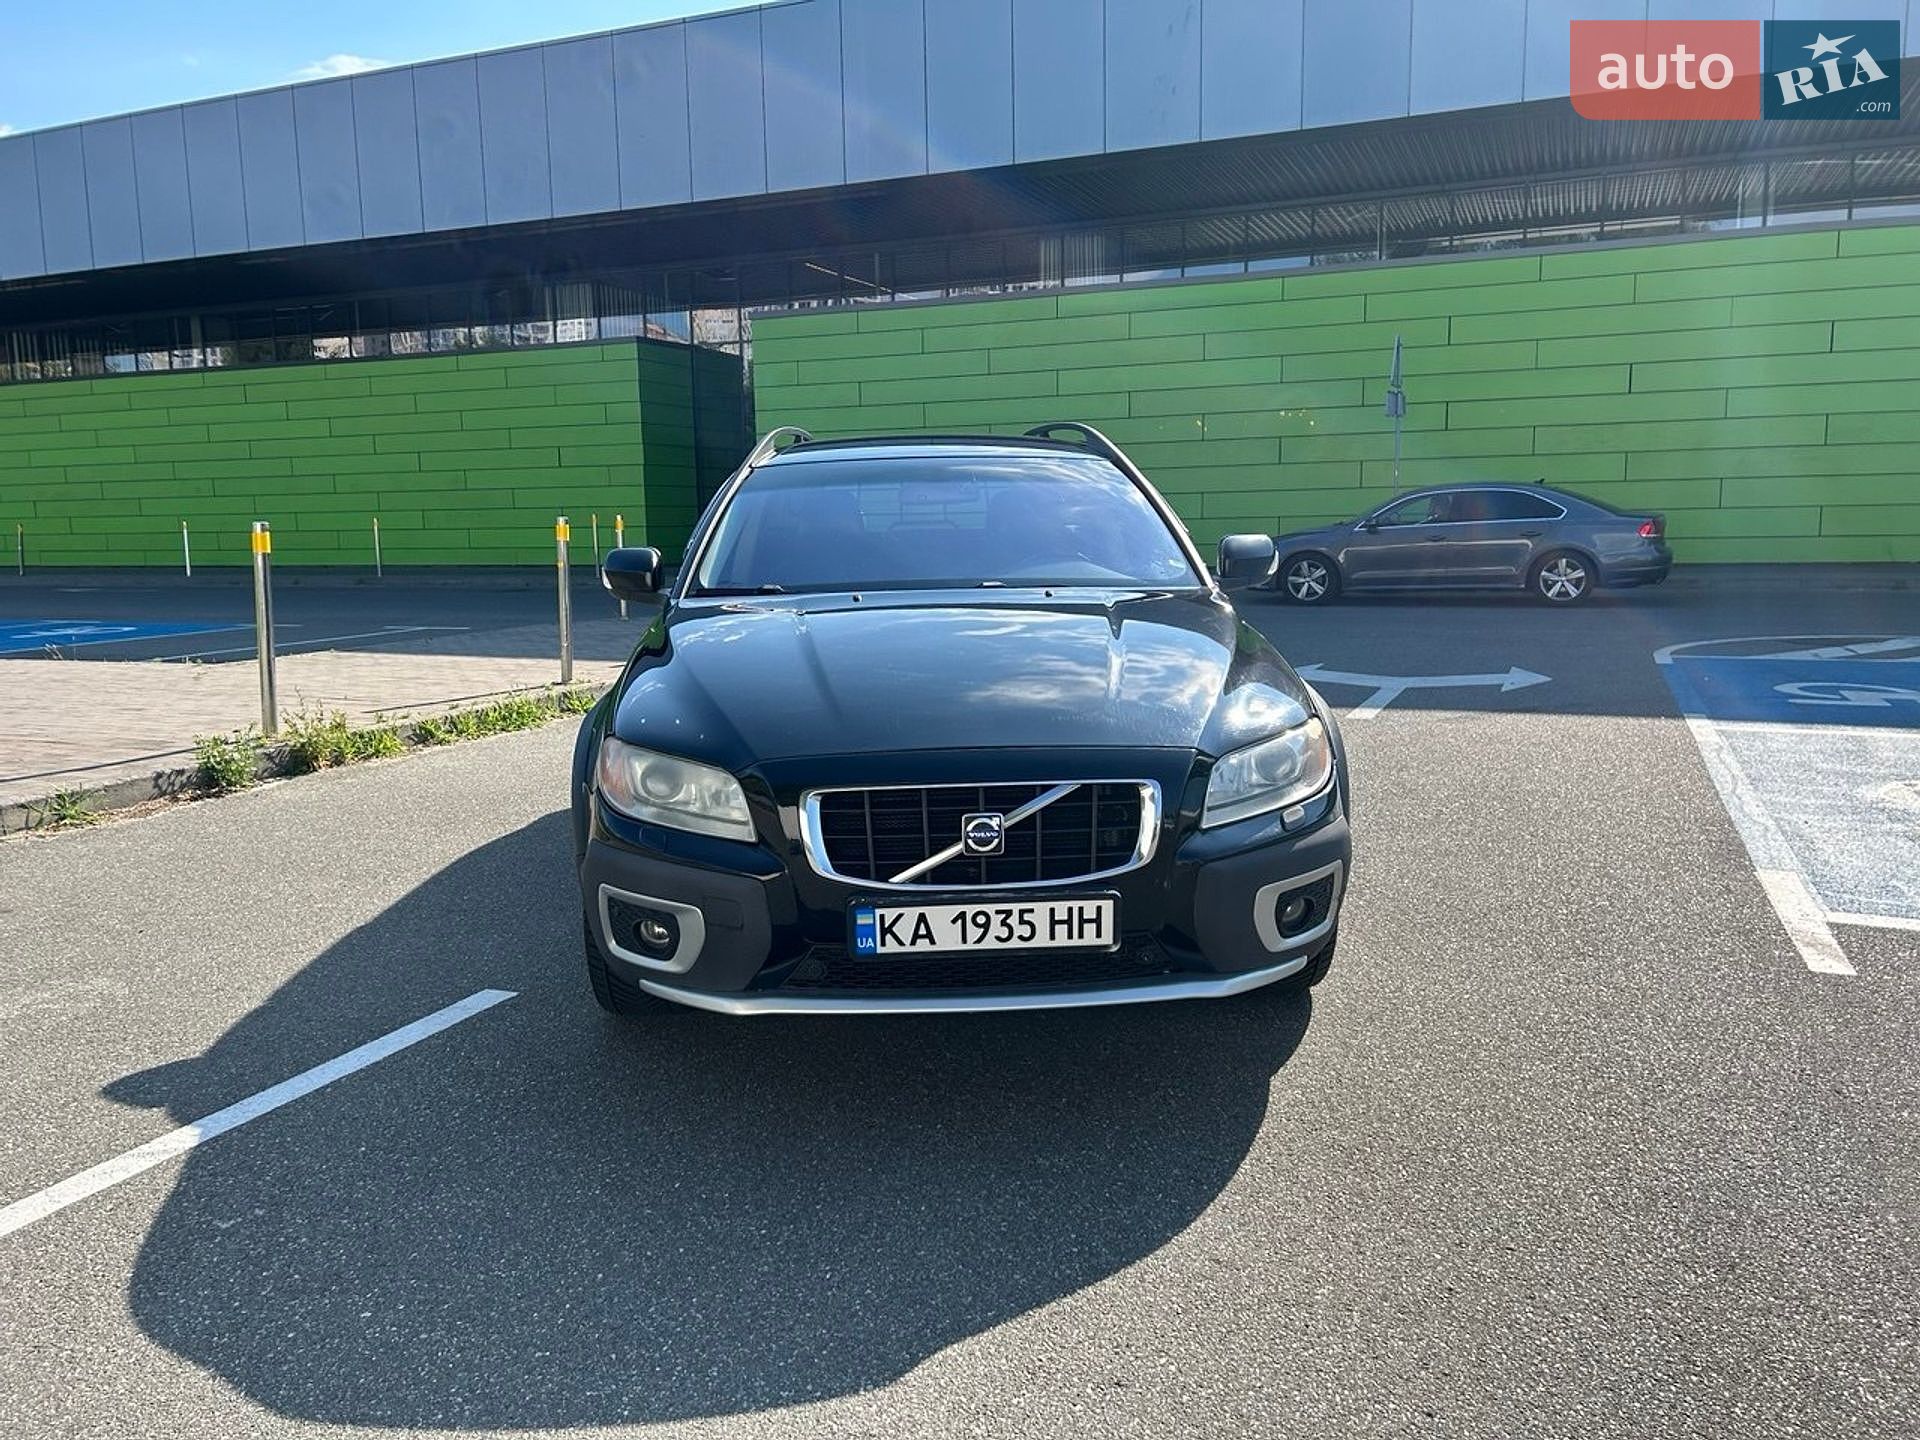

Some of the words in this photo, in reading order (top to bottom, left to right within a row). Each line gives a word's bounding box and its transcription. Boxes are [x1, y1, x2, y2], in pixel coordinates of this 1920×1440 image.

[878, 912, 937, 947] KA
[950, 908, 1037, 945] 1935
[1048, 905, 1103, 941] HH
[857, 937, 875, 948] UA
